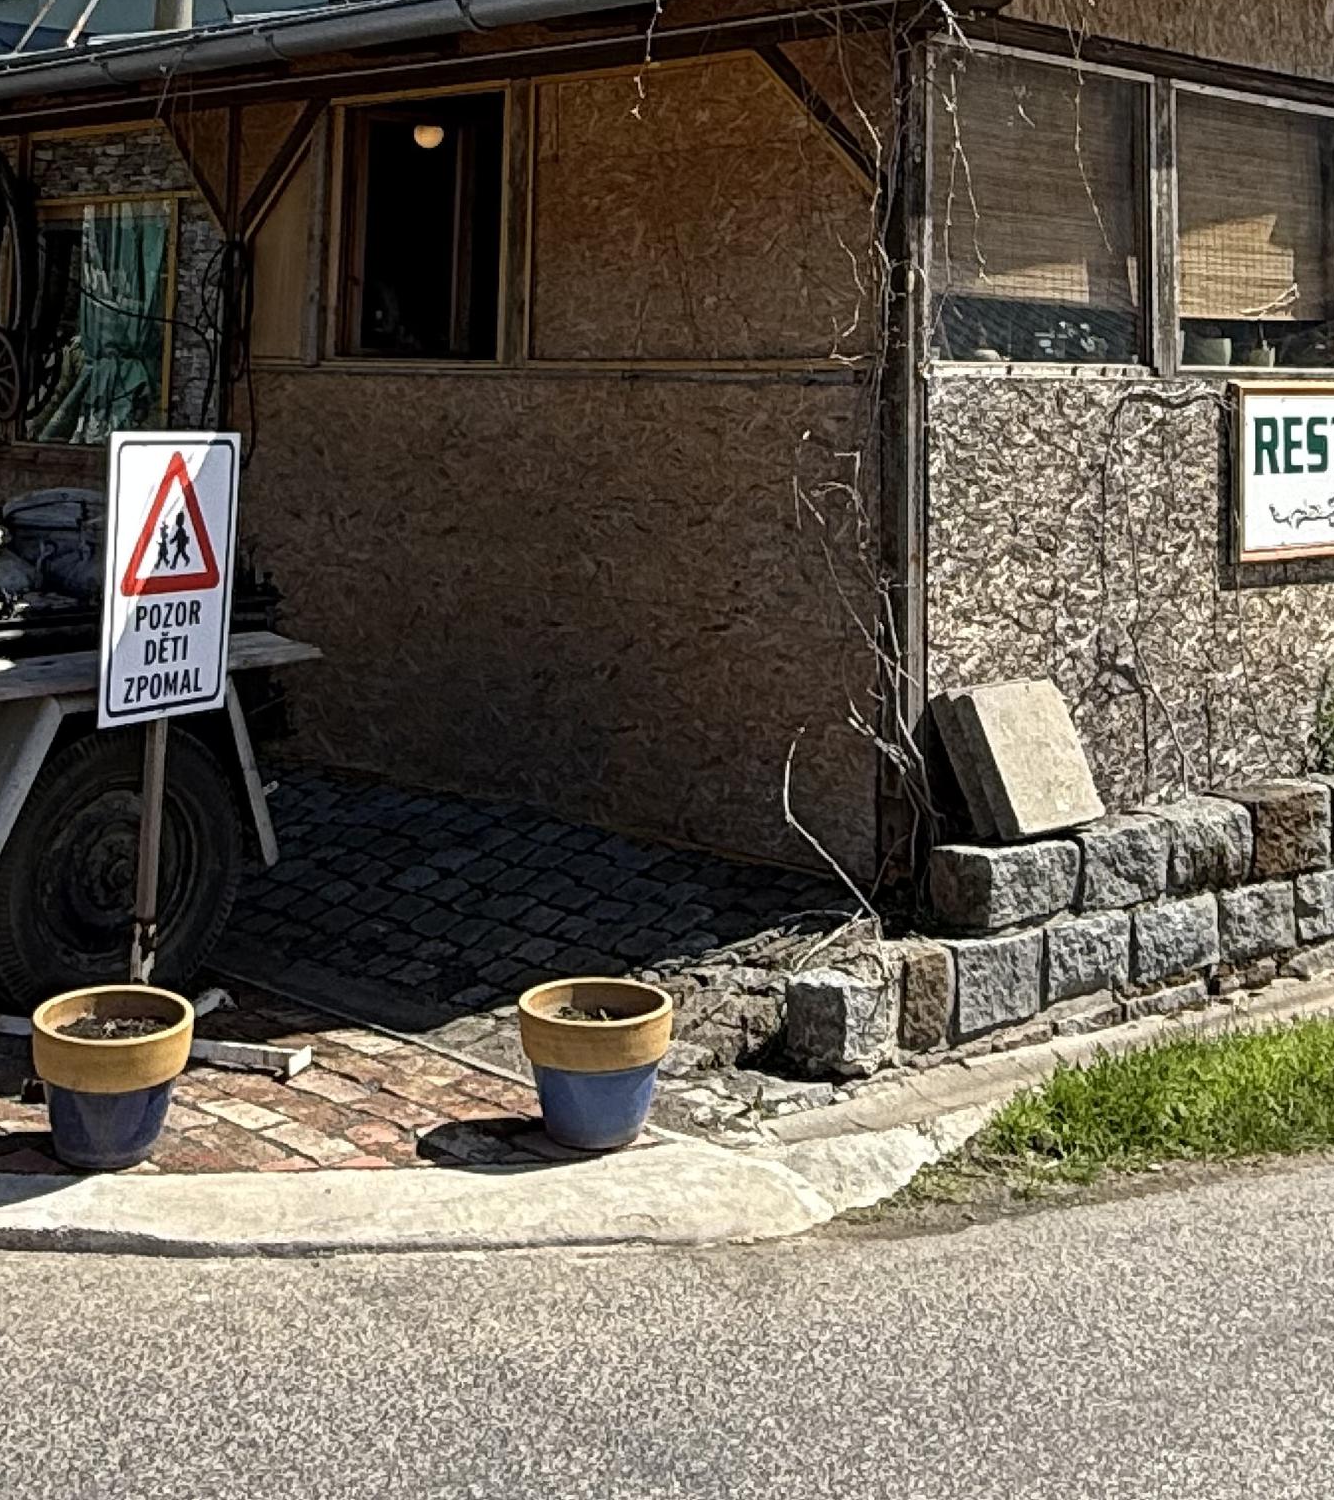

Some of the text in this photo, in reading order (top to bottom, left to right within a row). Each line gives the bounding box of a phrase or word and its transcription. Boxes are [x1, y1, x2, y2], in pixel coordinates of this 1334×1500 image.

[135, 600, 202, 632] POZOR
[144, 631, 188, 666] DĚTI
[123, 667, 202, 704] ZPOMAL
